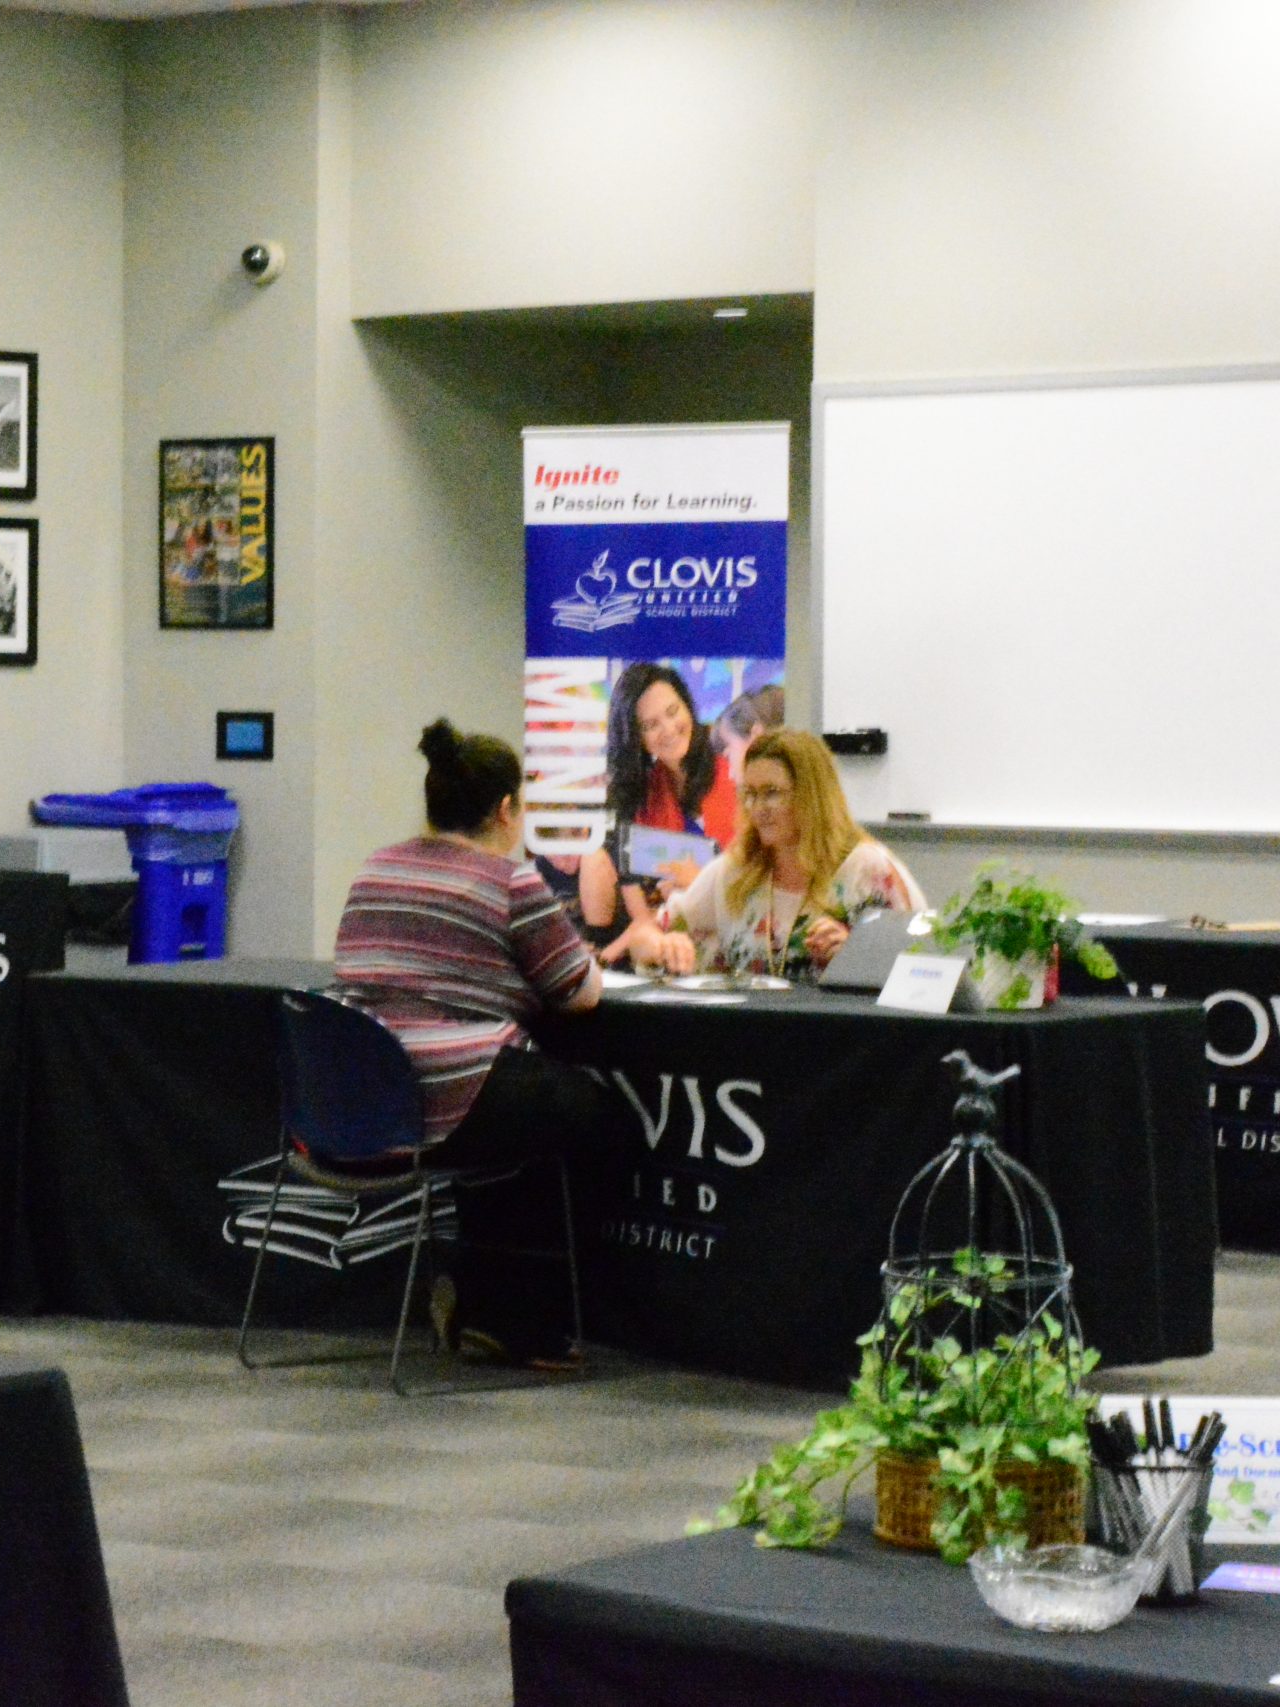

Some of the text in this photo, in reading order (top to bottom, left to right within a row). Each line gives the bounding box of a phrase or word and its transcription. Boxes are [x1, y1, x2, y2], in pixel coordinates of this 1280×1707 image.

[534, 464, 620, 491] Ignite
[240, 443, 266, 584] VALUES
[535, 492, 758, 515] a Passion for Learning.
[626, 555, 758, 589] CLOVIS
[524, 658, 608, 856] MIND
